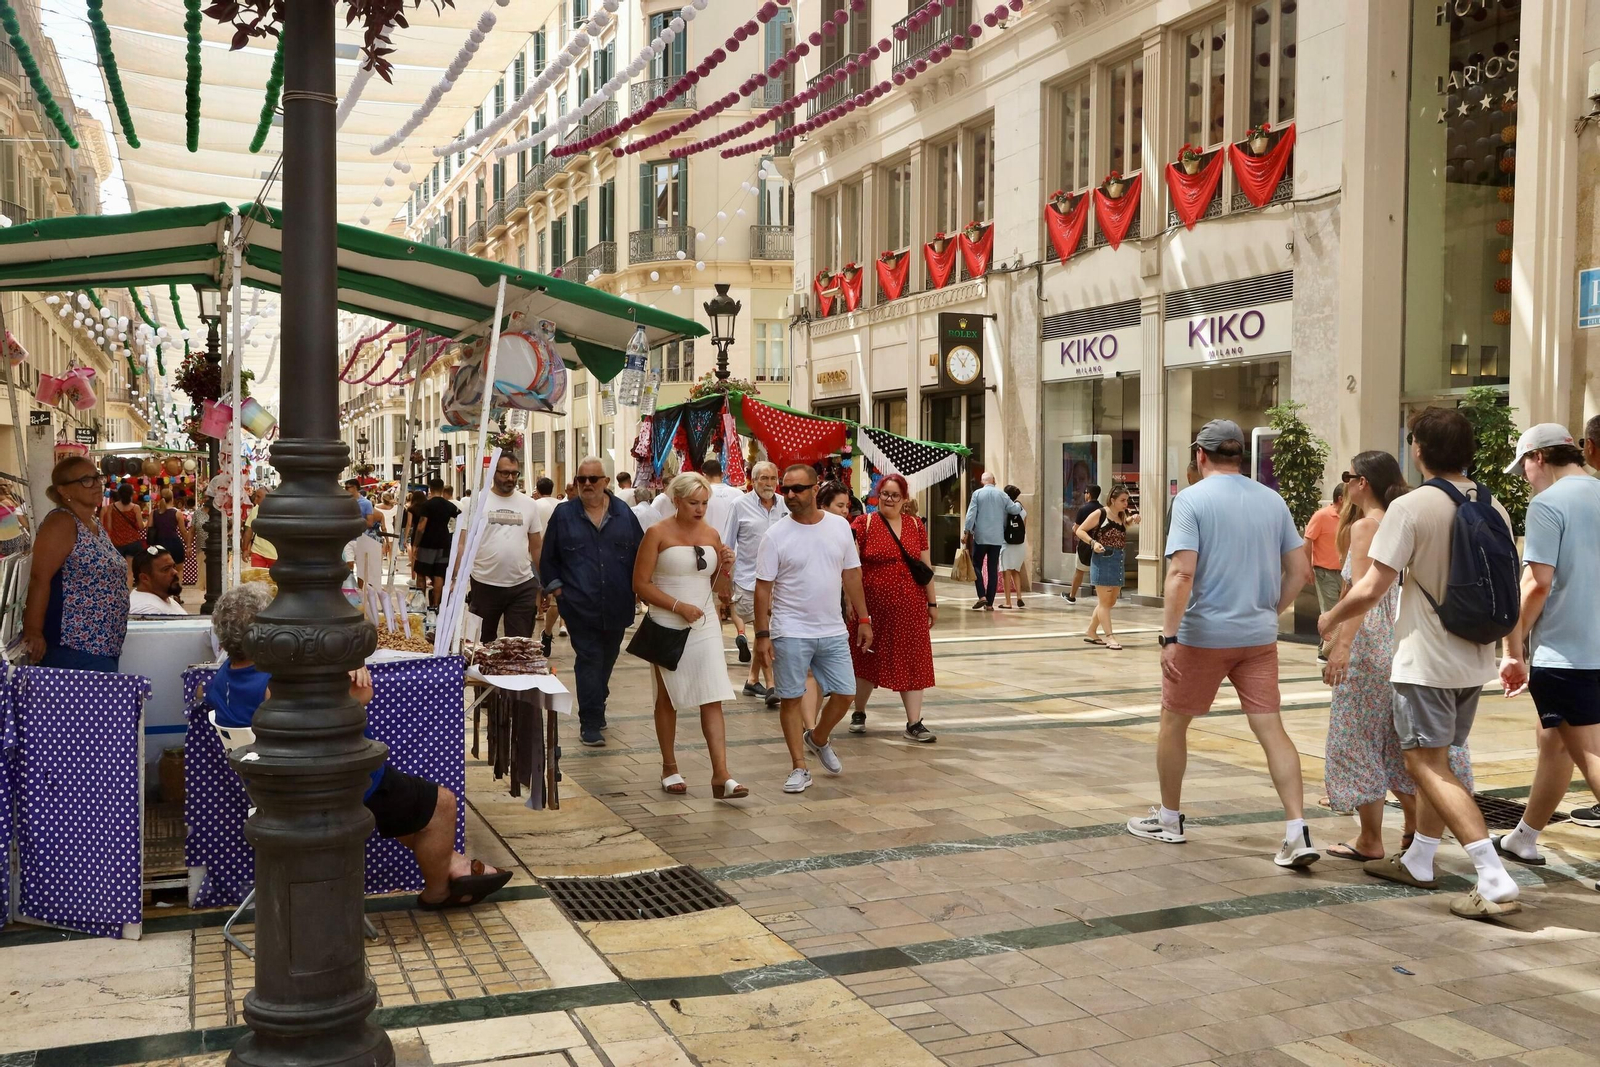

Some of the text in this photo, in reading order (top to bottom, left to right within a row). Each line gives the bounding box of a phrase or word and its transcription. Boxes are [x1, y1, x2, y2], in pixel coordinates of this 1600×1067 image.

[1435, 49, 1520, 96] LARIOS
[948, 329, 978, 339] ROLEX
[1188, 310, 1265, 348] KIKO
[1060, 334, 1118, 365] KIKO
[1208, 346, 1243, 360] MILANO
[1075, 365, 1102, 375] MILANO
[1346, 374, 1356, 392] 2
